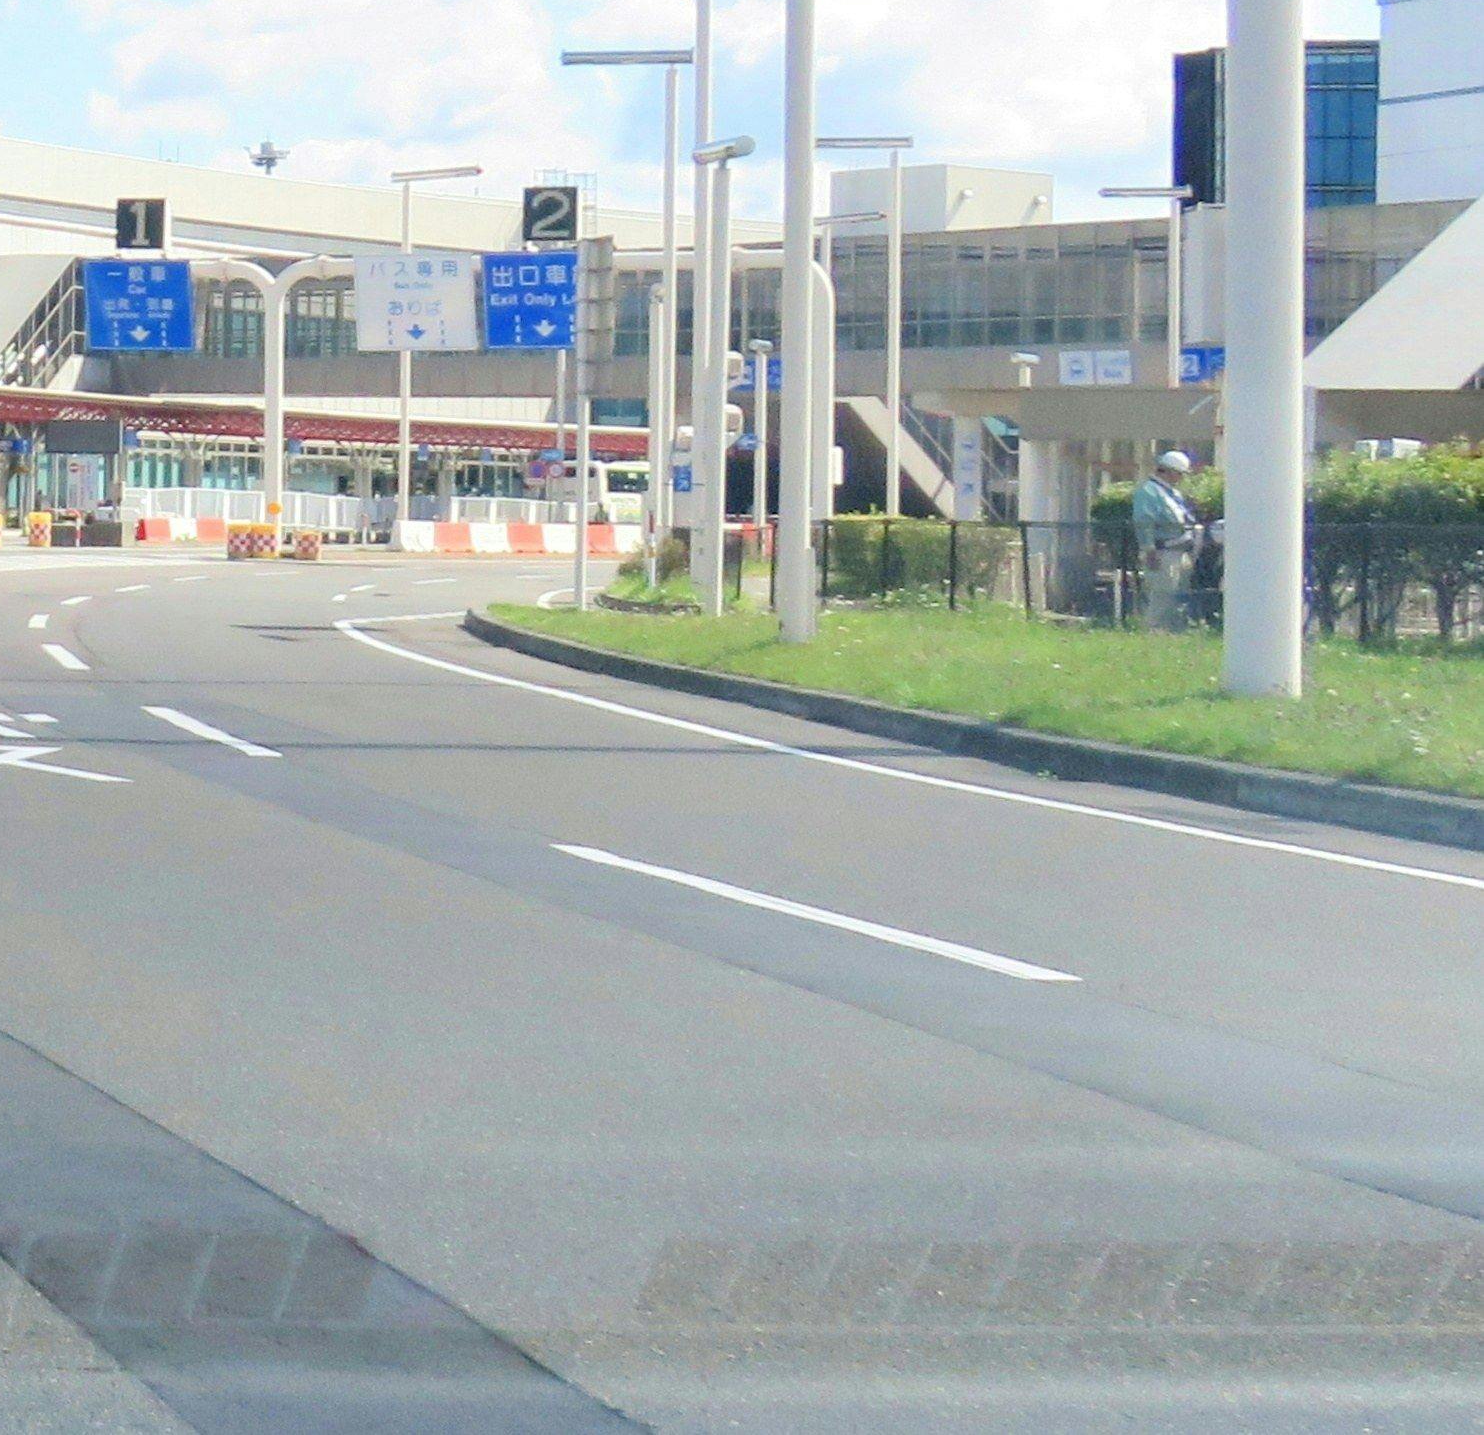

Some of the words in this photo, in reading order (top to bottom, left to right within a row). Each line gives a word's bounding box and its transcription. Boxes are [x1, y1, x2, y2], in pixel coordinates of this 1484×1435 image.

[129, 201, 151, 247] 1
[533, 190, 571, 238] 2
[492, 265, 577, 288] 出口車
